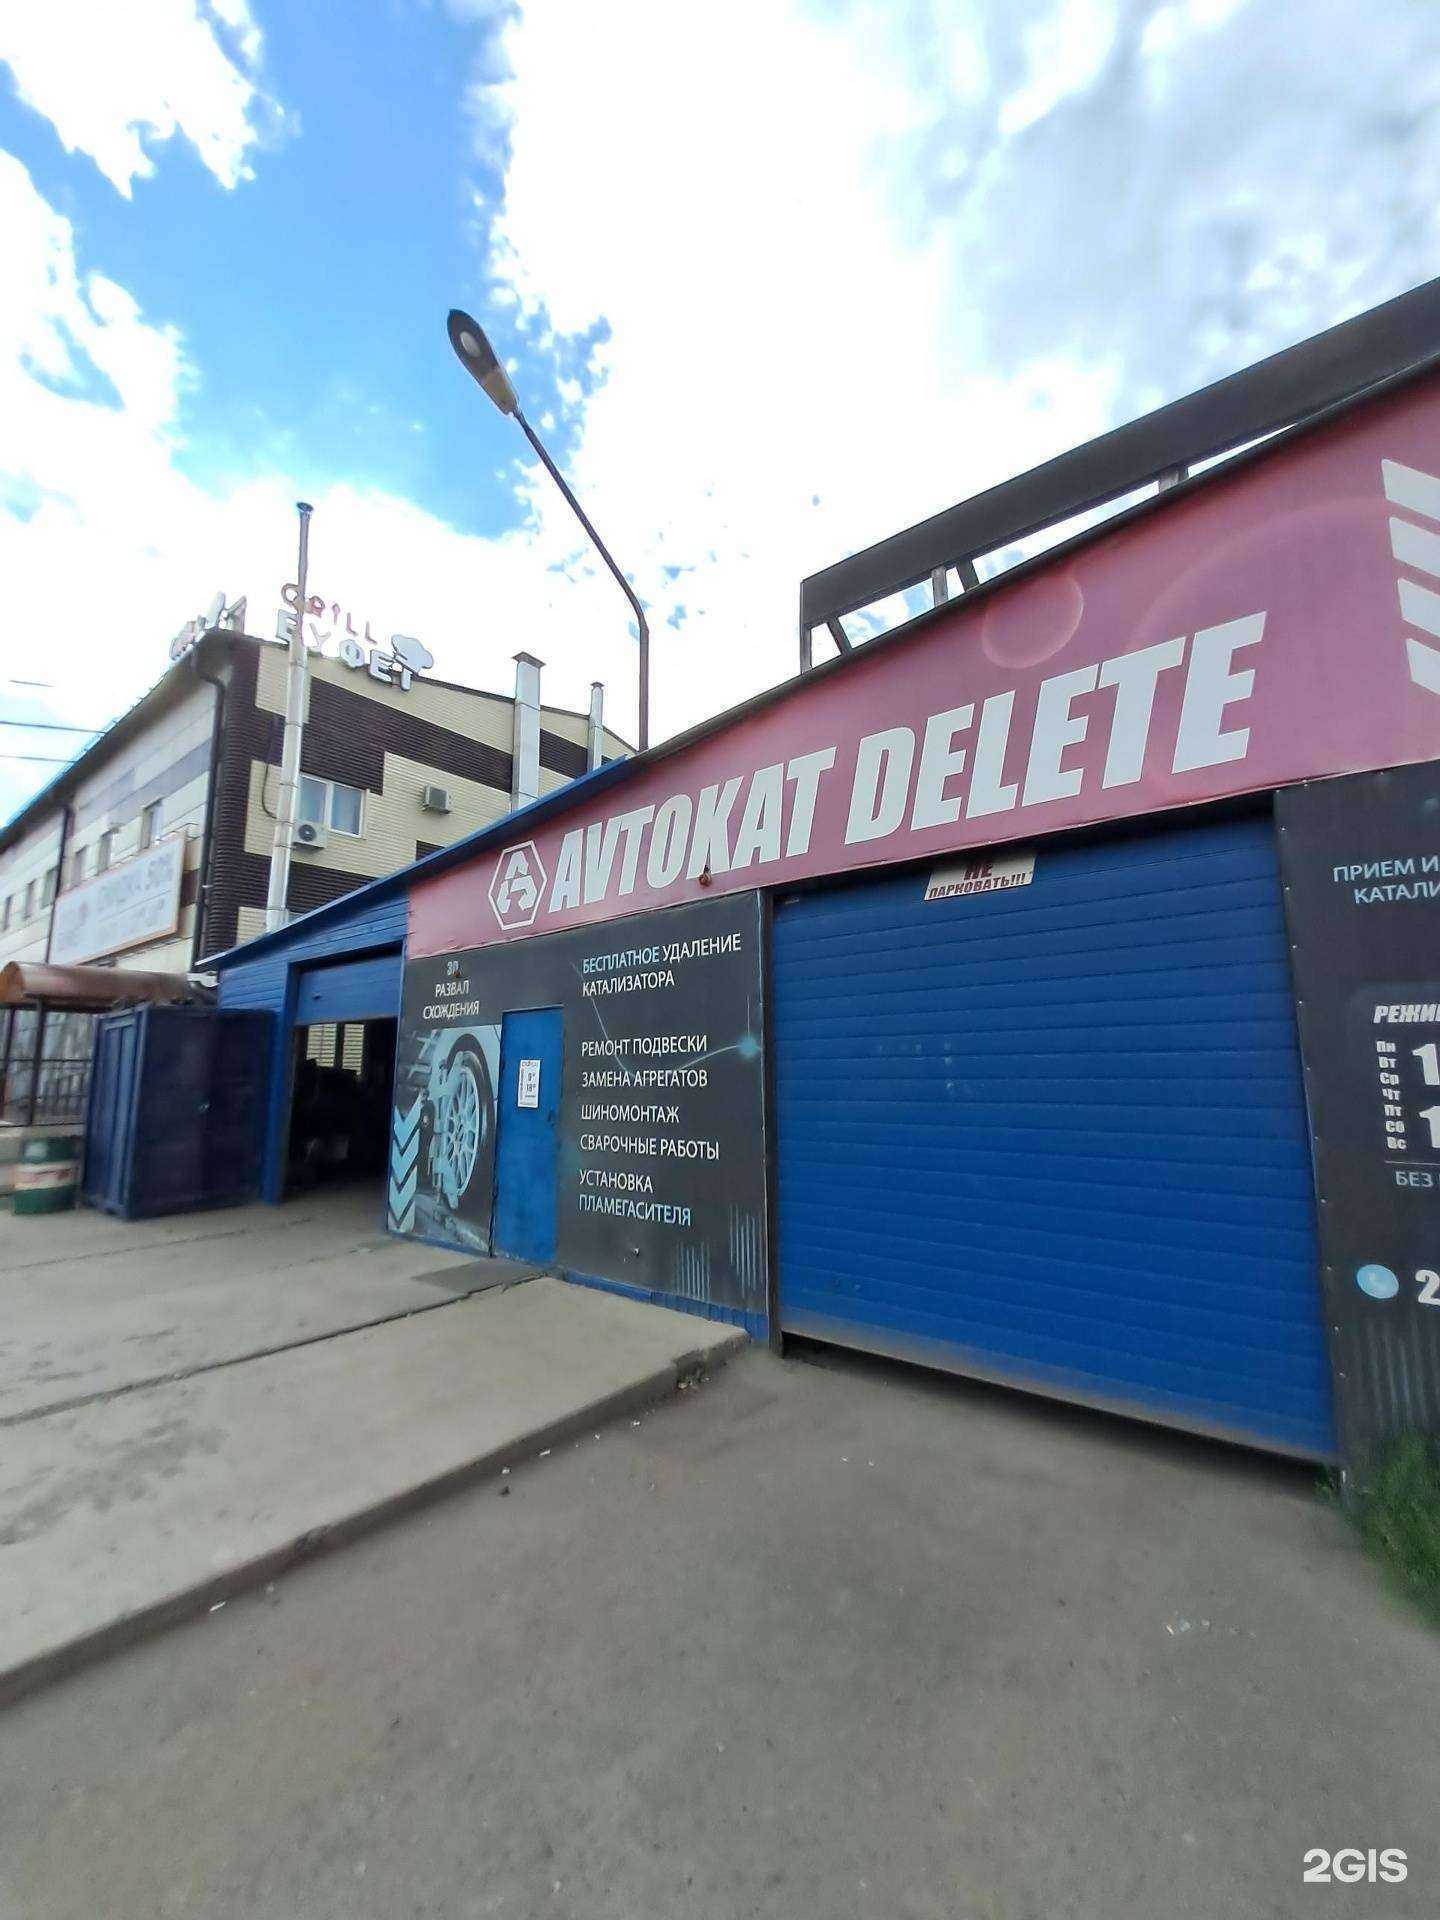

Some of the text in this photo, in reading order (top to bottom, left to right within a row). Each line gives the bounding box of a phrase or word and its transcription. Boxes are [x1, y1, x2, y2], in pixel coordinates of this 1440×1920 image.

[548, 611, 1267, 913] AVTOKAT DELETE
[963, 860, 994, 881] НЕ
[1333, 855, 1439, 882] ПРИЕМ И
[582, 933, 742, 974] БЕСПЛАТНОЕ УДАЛЕНИЕ
[435, 979, 470, 998] РАЗВАЛ
[582, 969, 675, 997] КАТАЛИЗАТОРА
[423, 1000, 480, 1021] СХОЖДЕНИЯ
[581, 1034, 708, 1057] РЕМОНТ ПОДВЕСКИ
[581, 1069, 708, 1088] ЗАМЕНА АГРЕГАТОВ
[581, 1104, 680, 1124] ШИНОМОНТАЖ
[580, 1134, 720, 1161] СВАРОЧНЫЕ РАБОТЫ
[579, 1168, 654, 1194] УСТАНОВКА
[1395, 1170, 1434, 1188] БЕЗ
[578, 1194, 692, 1227] ПЛАМЕГАСИТЕЛЯ
